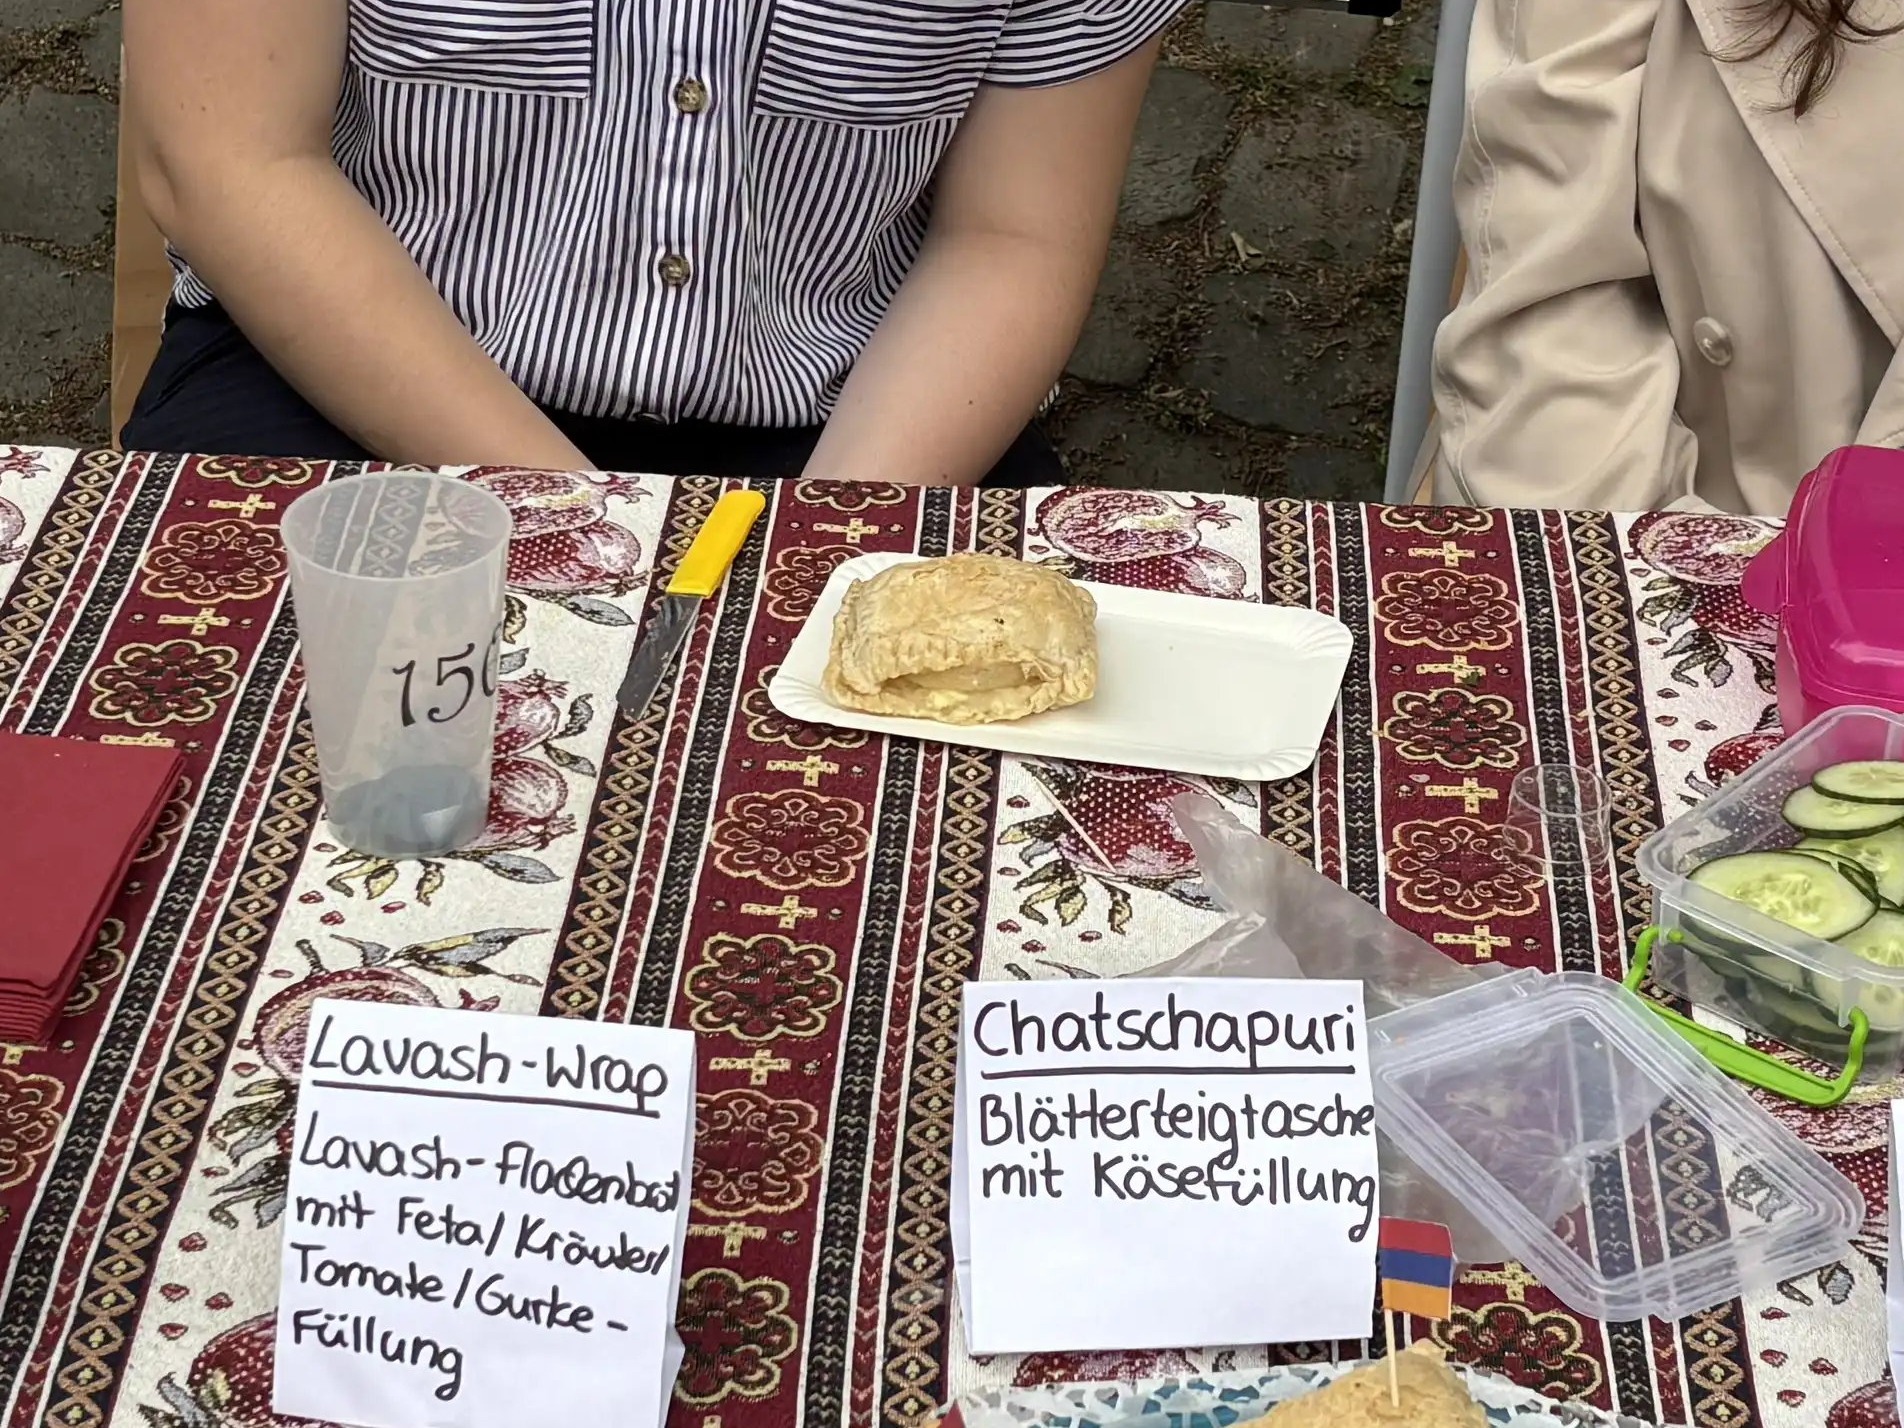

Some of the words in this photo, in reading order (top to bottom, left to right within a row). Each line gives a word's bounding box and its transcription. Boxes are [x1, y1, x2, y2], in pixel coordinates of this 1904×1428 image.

[310, 1015, 669, 1115] Lavash-Wrap
[974, 991, 1355, 1070] Chatschapuri
[979, 1088, 1376, 1171] Blätterteigtasche
[296, 1190, 374, 1229] mit
[982, 1148, 1064, 1199] mit
[1093, 1152, 1376, 1243] Käsefüllung
[293, 1308, 464, 1401] Füllung
